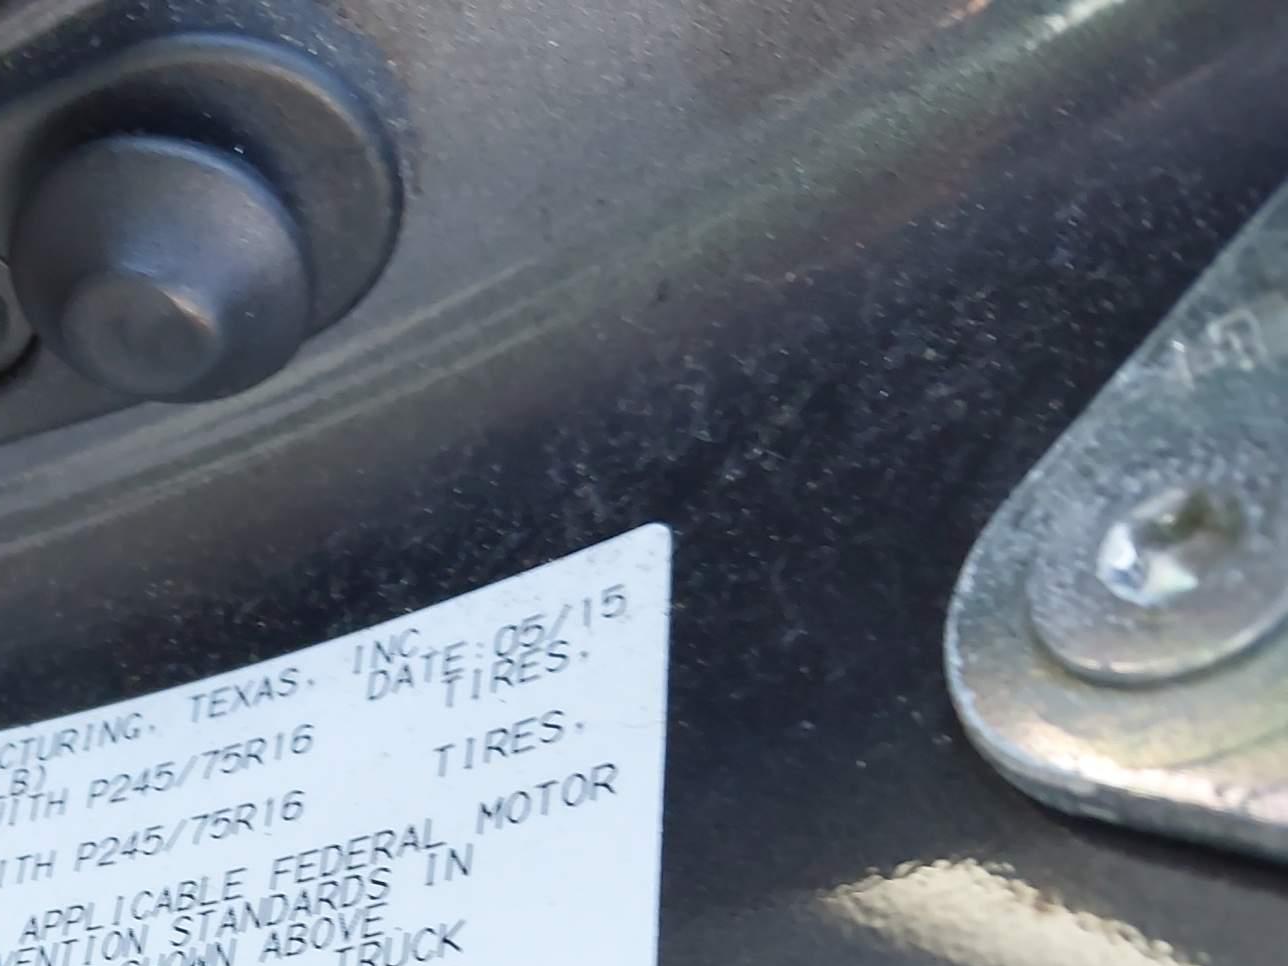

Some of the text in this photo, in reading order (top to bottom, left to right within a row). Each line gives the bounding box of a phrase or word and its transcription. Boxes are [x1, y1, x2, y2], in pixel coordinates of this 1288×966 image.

[366, 583, 627, 700] DATE:05/15
[88, 724, 314, 809] P245/75R16
[17, 867, 249, 945] APPLICABLE
[268, 818, 447, 890] FEDERAL
[475, 762, 620, 835] MOTOR
[74, 789, 305, 872] P245/75R16
[169, 866, 391, 947] STANDARDS
[424, 842, 475, 886] IN
